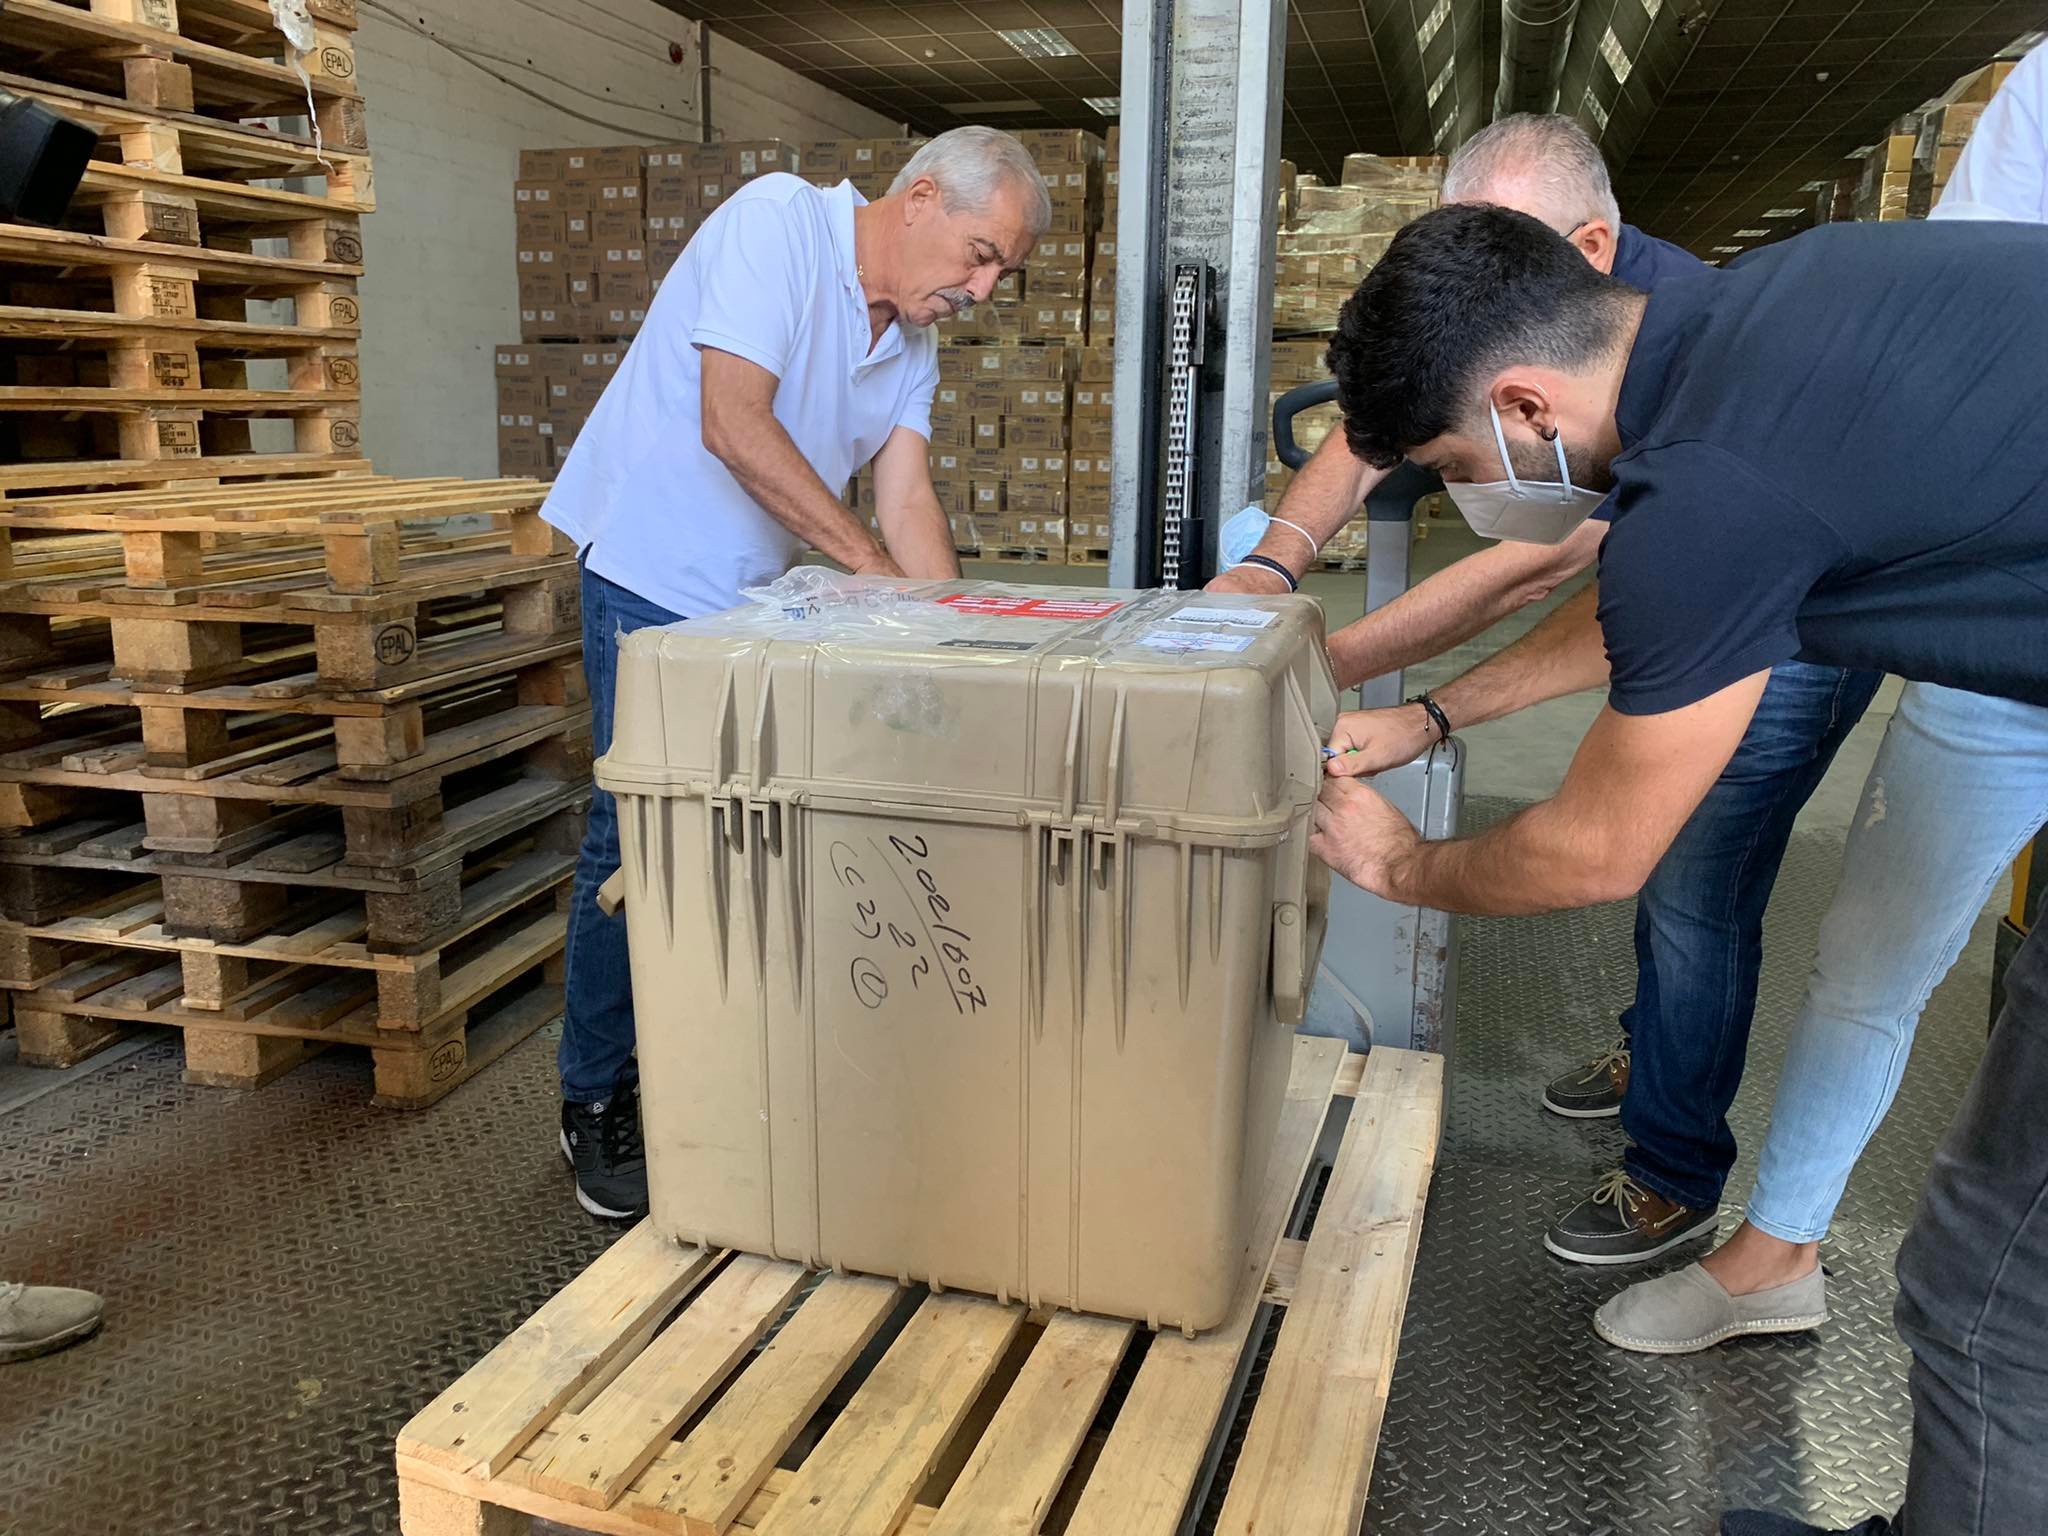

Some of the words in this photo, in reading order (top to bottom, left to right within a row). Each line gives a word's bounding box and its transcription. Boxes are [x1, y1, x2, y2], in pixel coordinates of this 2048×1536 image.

[325, 51, 350, 74] EPAL
[334, 426, 358, 442] EPAL
[380, 630, 411, 660] EPAL
[432, 1046, 461, 1078] EPAL
